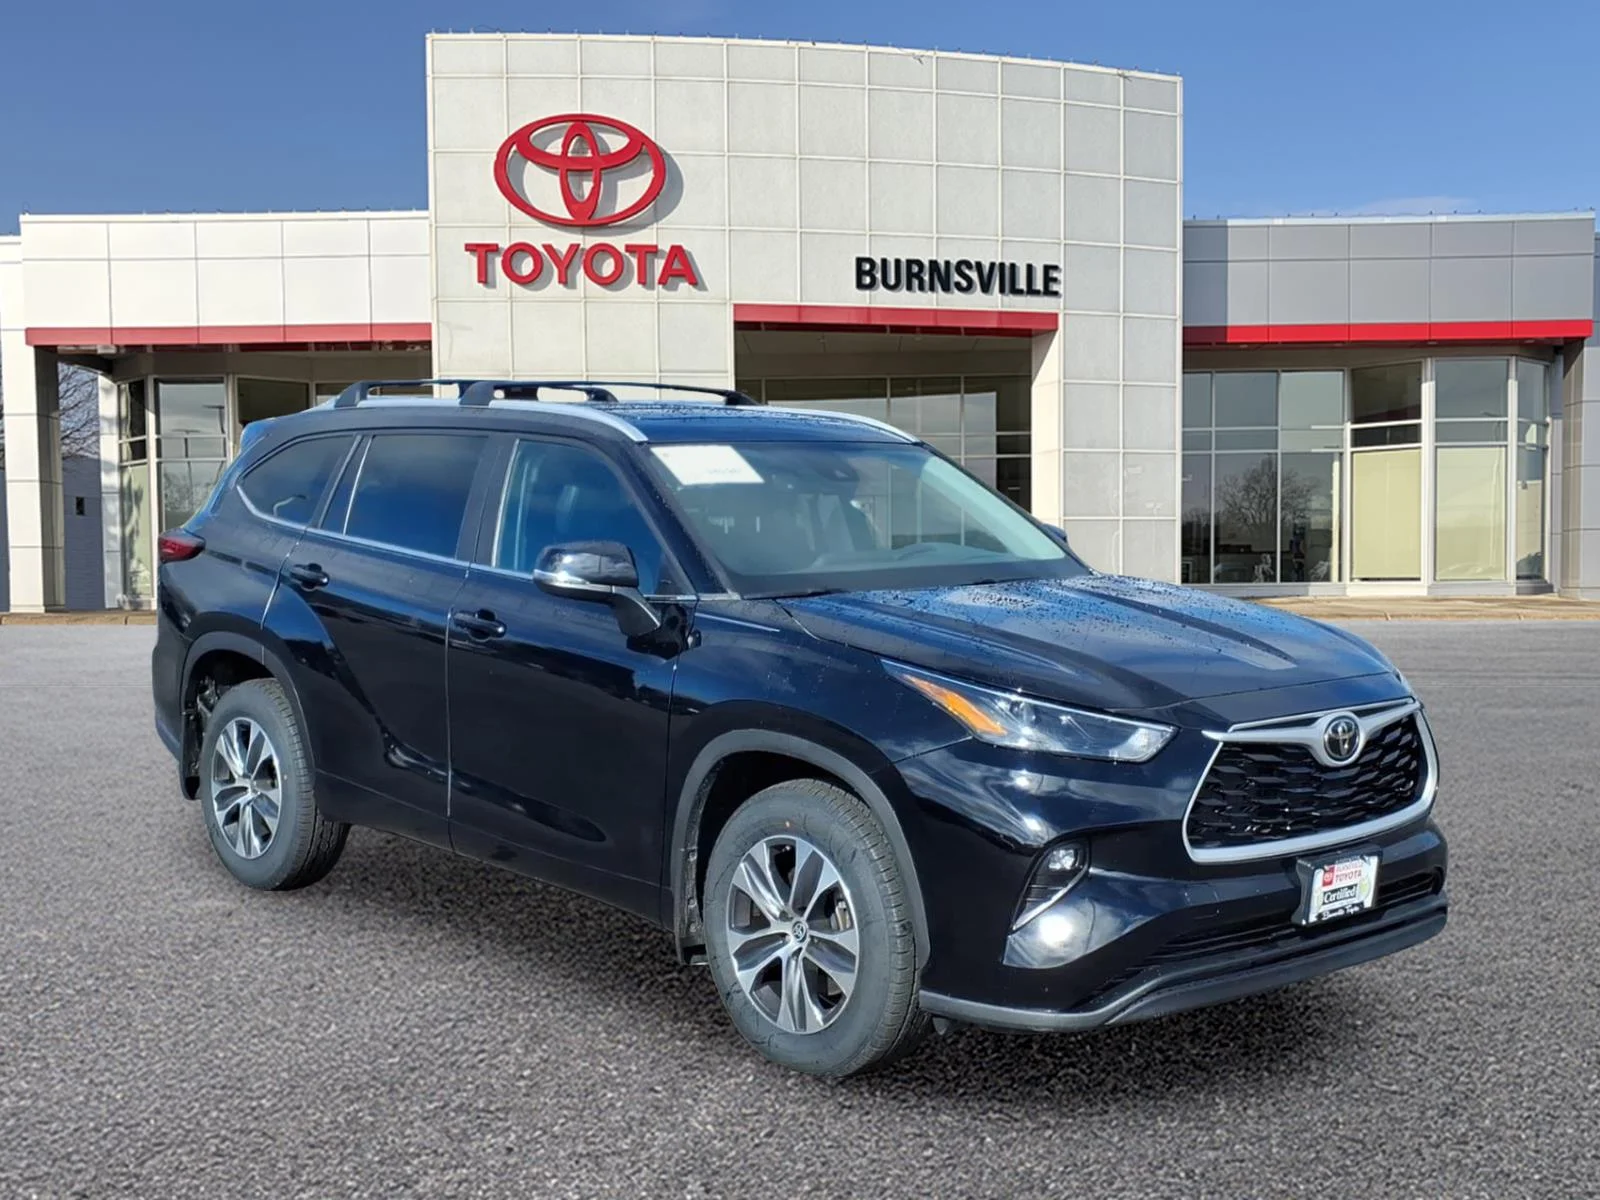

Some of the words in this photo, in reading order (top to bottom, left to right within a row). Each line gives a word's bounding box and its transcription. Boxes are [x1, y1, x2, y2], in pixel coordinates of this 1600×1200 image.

[464, 242, 698, 285] TOYOTA
[855, 257, 1062, 297] BURNSVILLE
[1335, 869, 1362, 883] TOYOTA
[1324, 885, 1356, 903] Certified
